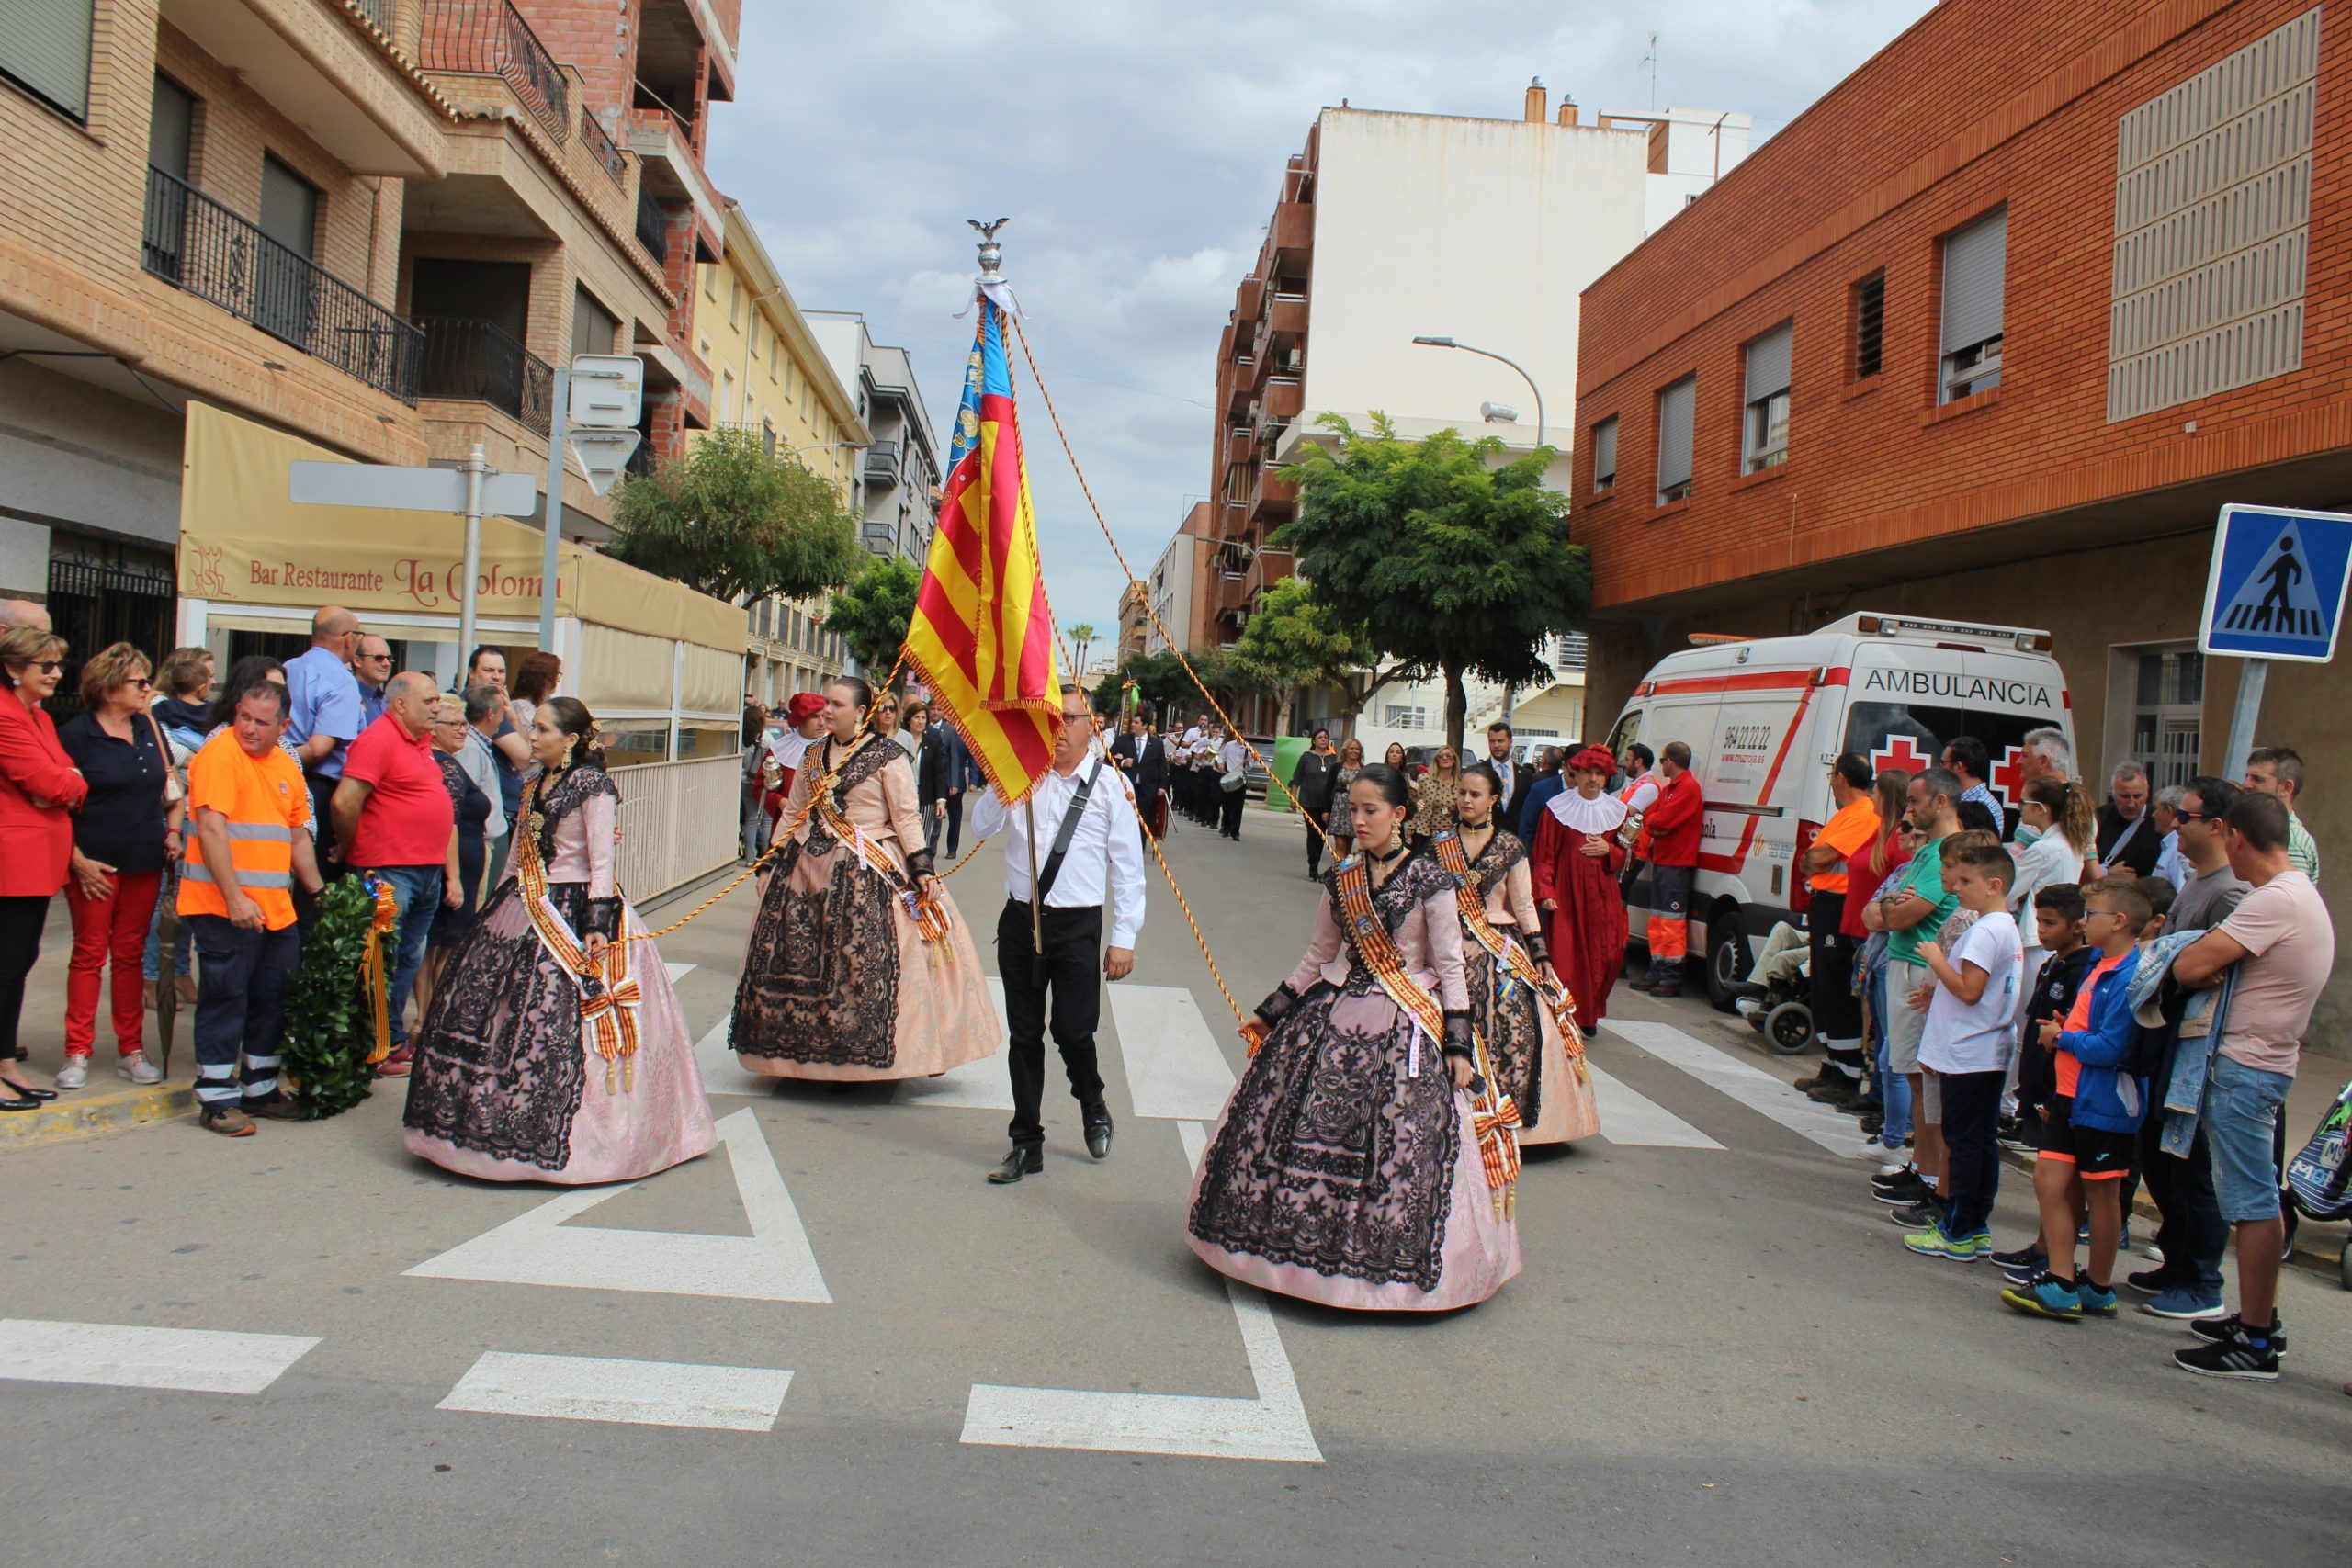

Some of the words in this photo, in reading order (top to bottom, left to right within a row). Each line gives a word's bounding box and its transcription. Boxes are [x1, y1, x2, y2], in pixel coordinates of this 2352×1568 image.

[249, 559, 279, 585] Bar
[283, 561, 383, 592] Restaurante
[393, 558, 439, 608] La
[1865, 669, 2052, 708] AMBULANCIA
